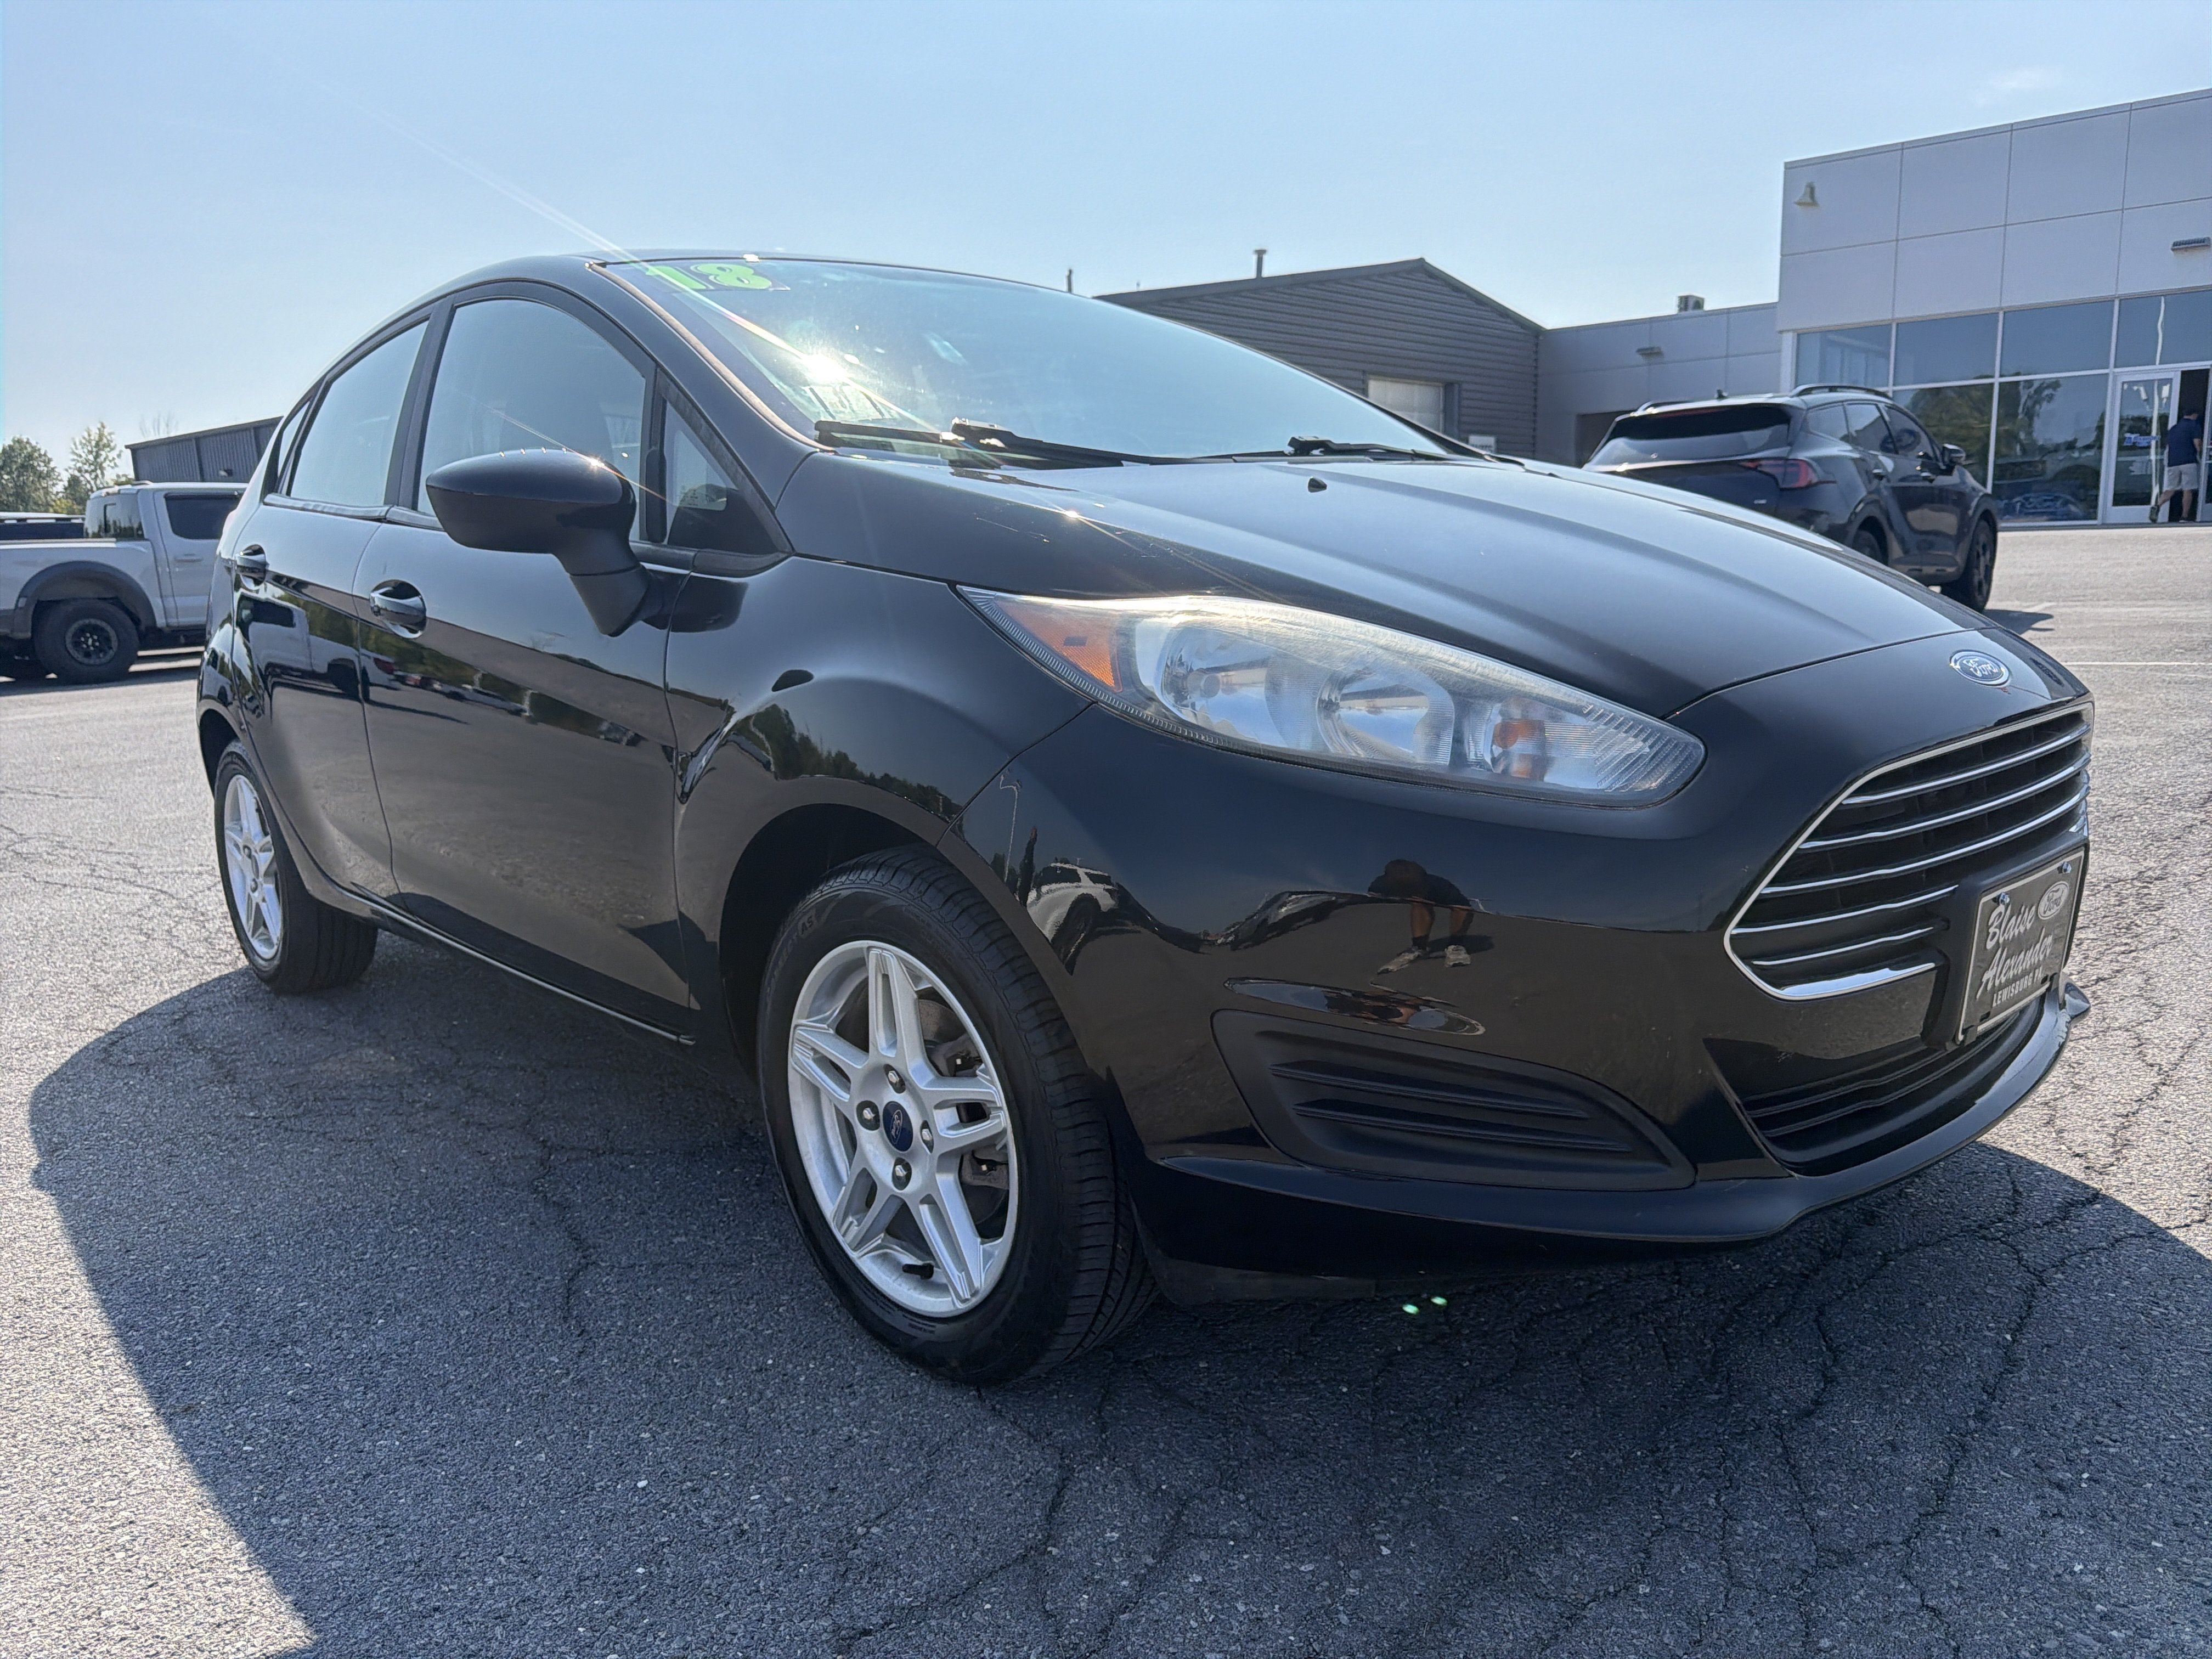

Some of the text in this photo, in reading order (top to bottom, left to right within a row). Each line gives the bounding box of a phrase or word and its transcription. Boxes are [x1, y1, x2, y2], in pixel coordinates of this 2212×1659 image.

[645, 263, 772, 290] 18
[1962, 658, 1999, 678] Ford
[2043, 888, 2064, 915] Ford
[1986, 904, 2036, 949] Blaise
[1976, 927, 2053, 1000] Alexander
[1992, 972, 2033, 1007] LEWISBURG
